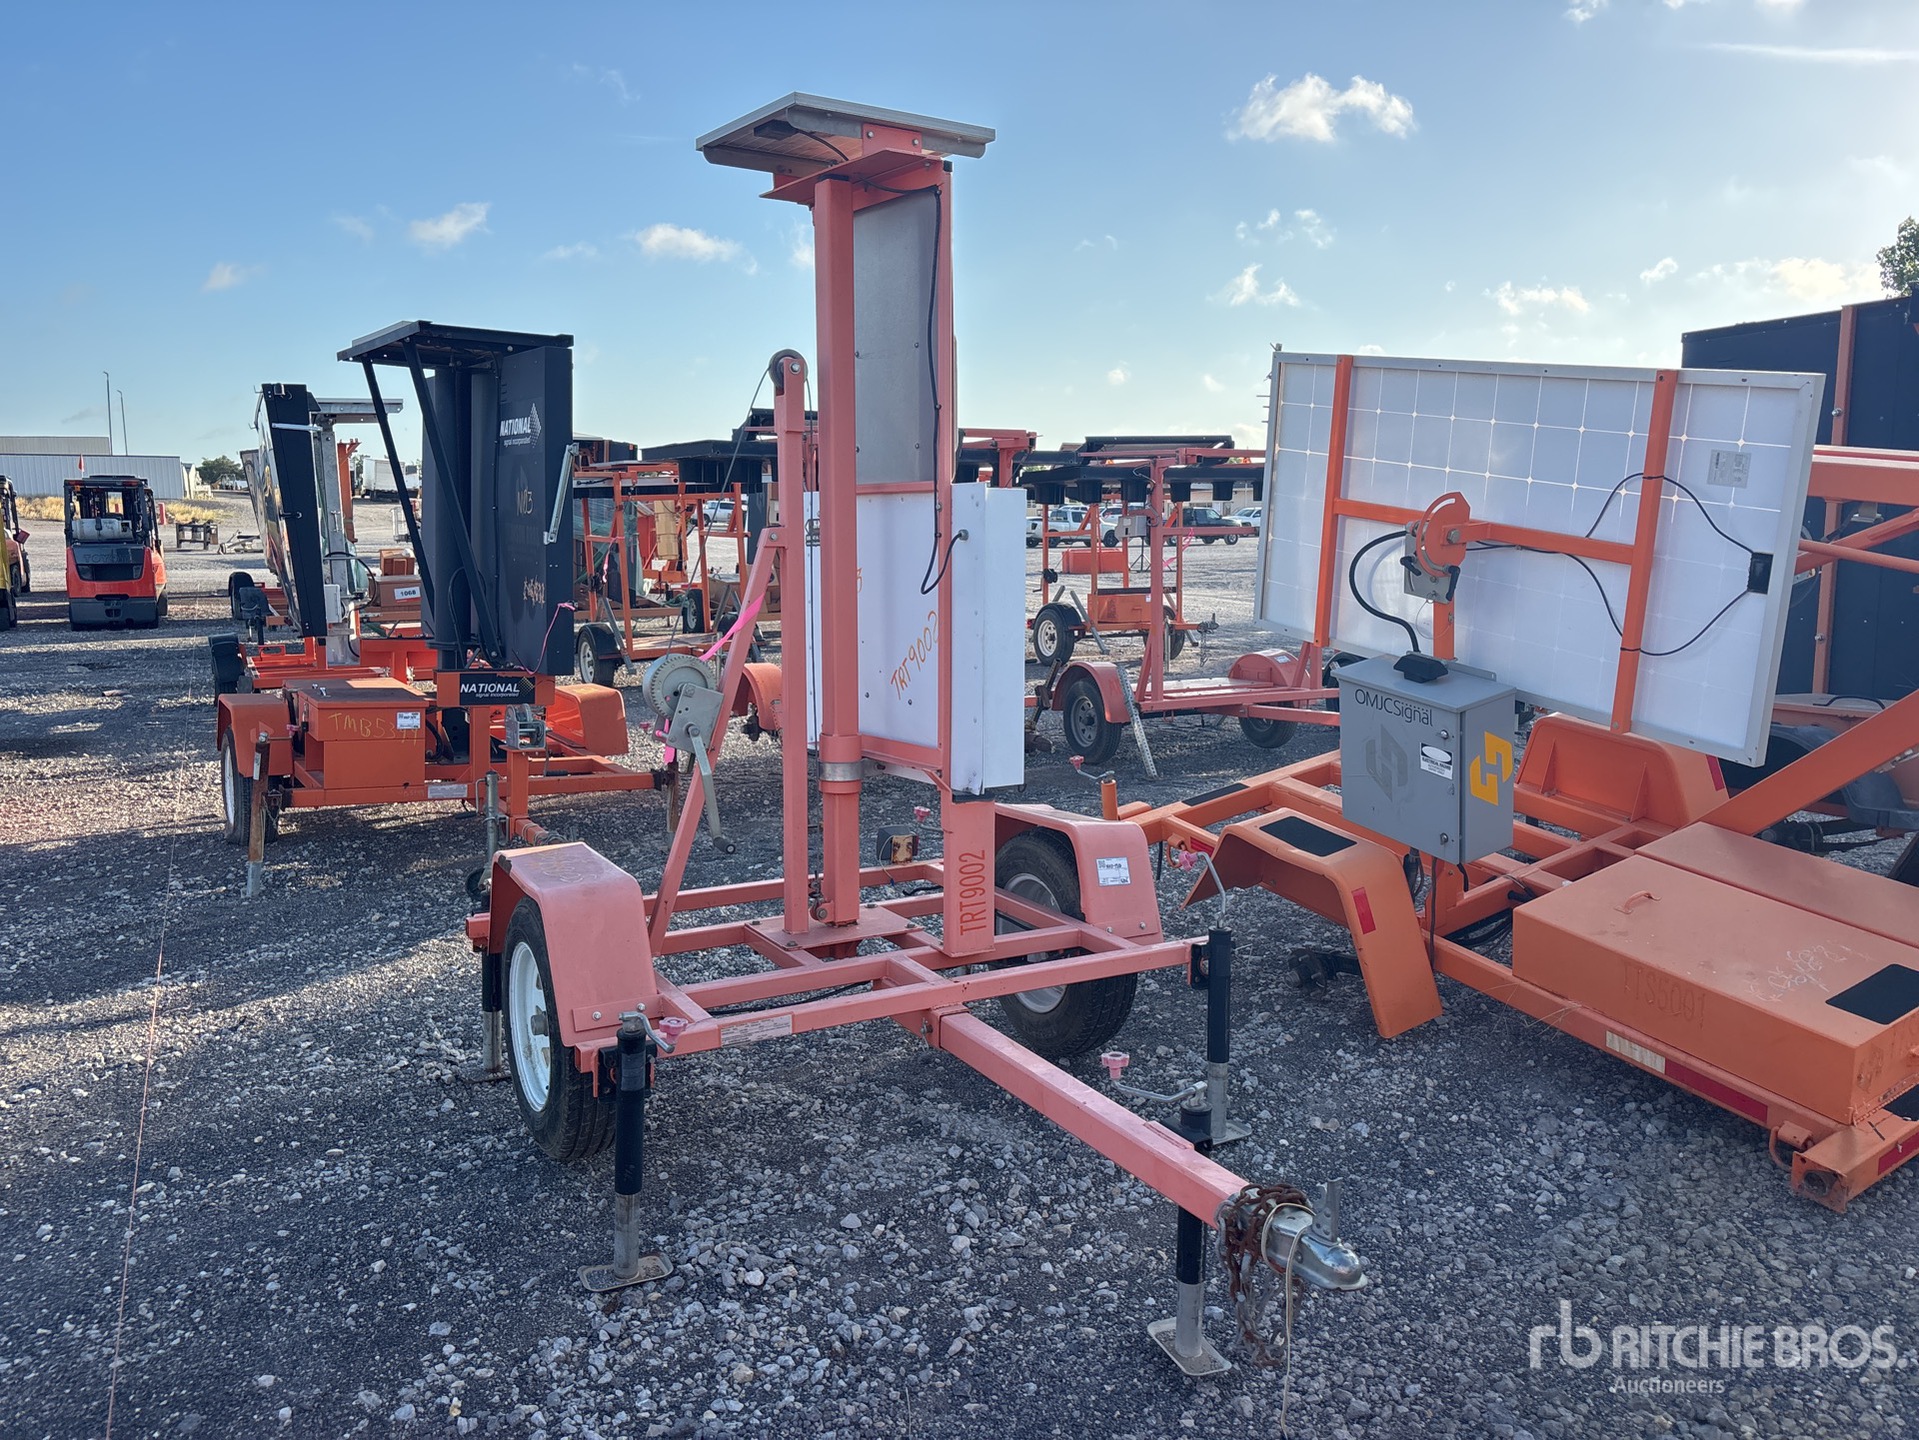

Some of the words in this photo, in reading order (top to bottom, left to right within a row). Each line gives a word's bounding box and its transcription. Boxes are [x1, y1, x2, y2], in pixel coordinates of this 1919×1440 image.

[500, 416, 531, 437] NATIONAL
[890, 610, 939, 701] TRT9002
[460, 683, 520, 693] NATIONAL
[1354, 688, 1434, 727] OMJCSignal
[958, 849, 987, 936] TRT9002
